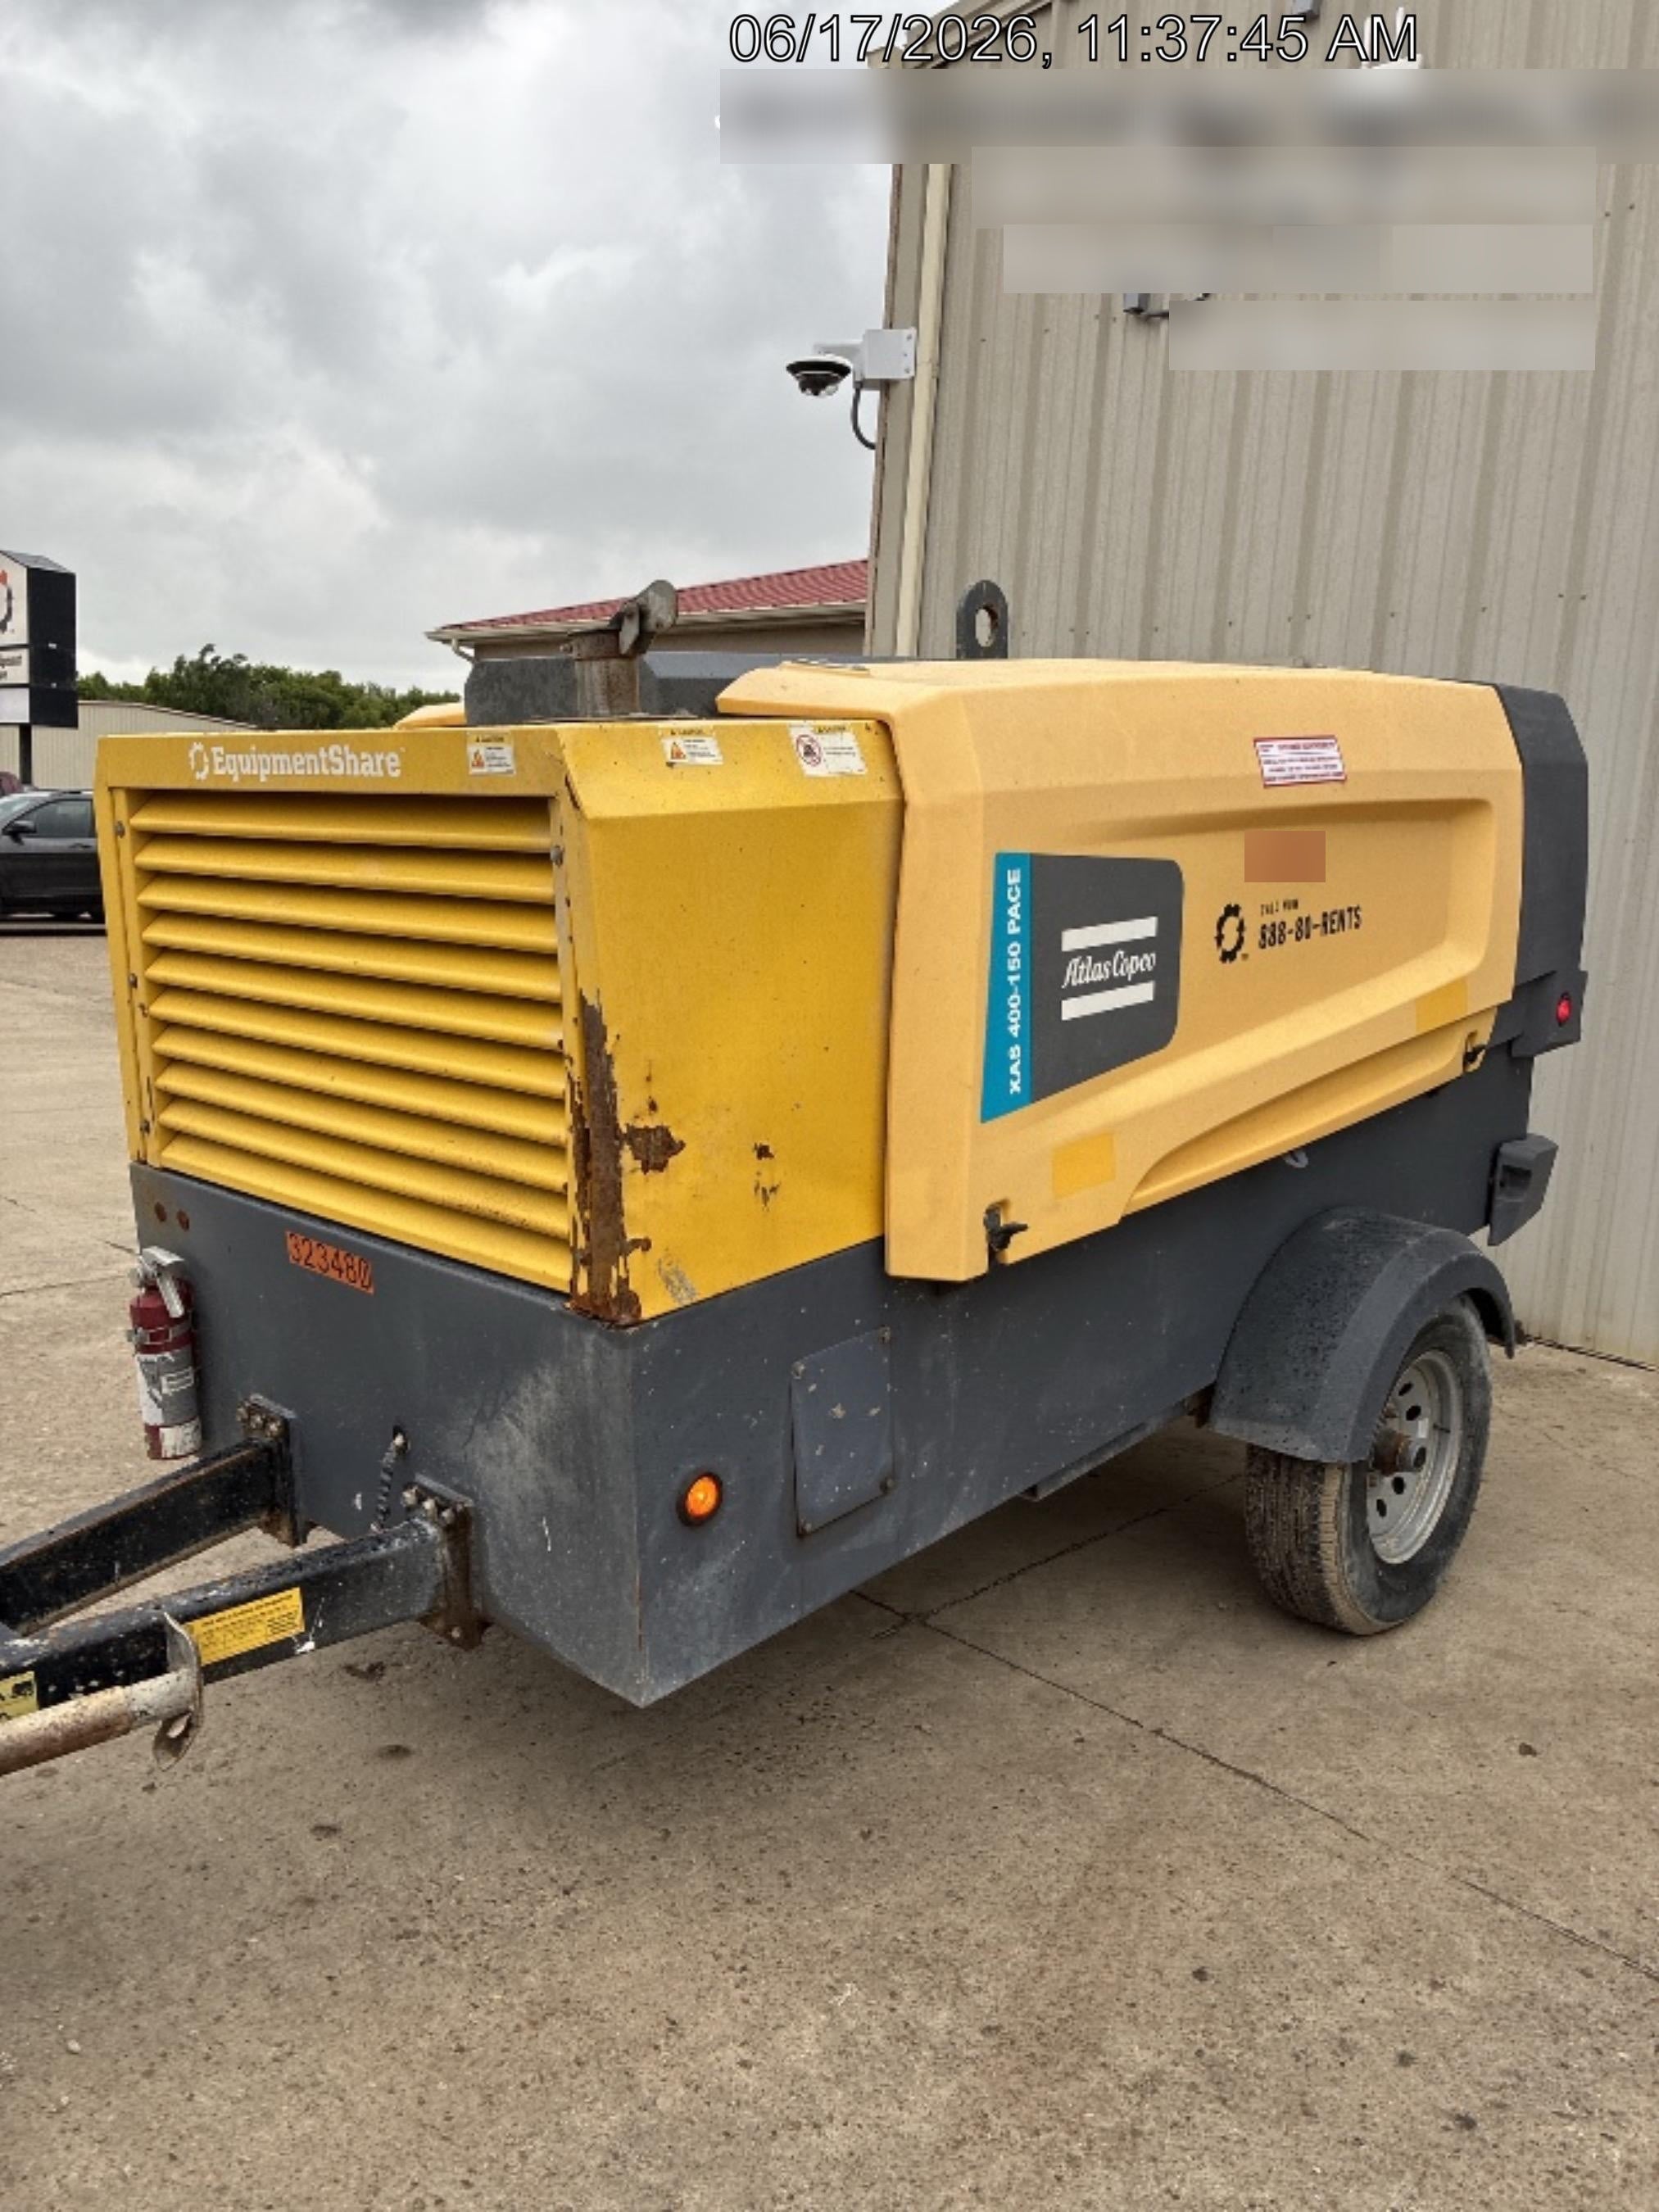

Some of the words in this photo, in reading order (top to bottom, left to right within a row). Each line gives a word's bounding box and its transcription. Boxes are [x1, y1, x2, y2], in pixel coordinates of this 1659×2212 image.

[211, 744, 401, 782] EquipmentShare
[1008, 869, 1021, 935] PACE
[1258, 904, 1362, 950] 888-80-RENTS
[1008, 941, 1021, 1038] 400-150
[1062, 955, 1112, 988] Atlas
[1112, 949, 1156, 981] Copco
[1009, 1044, 1021, 1095] XAS
